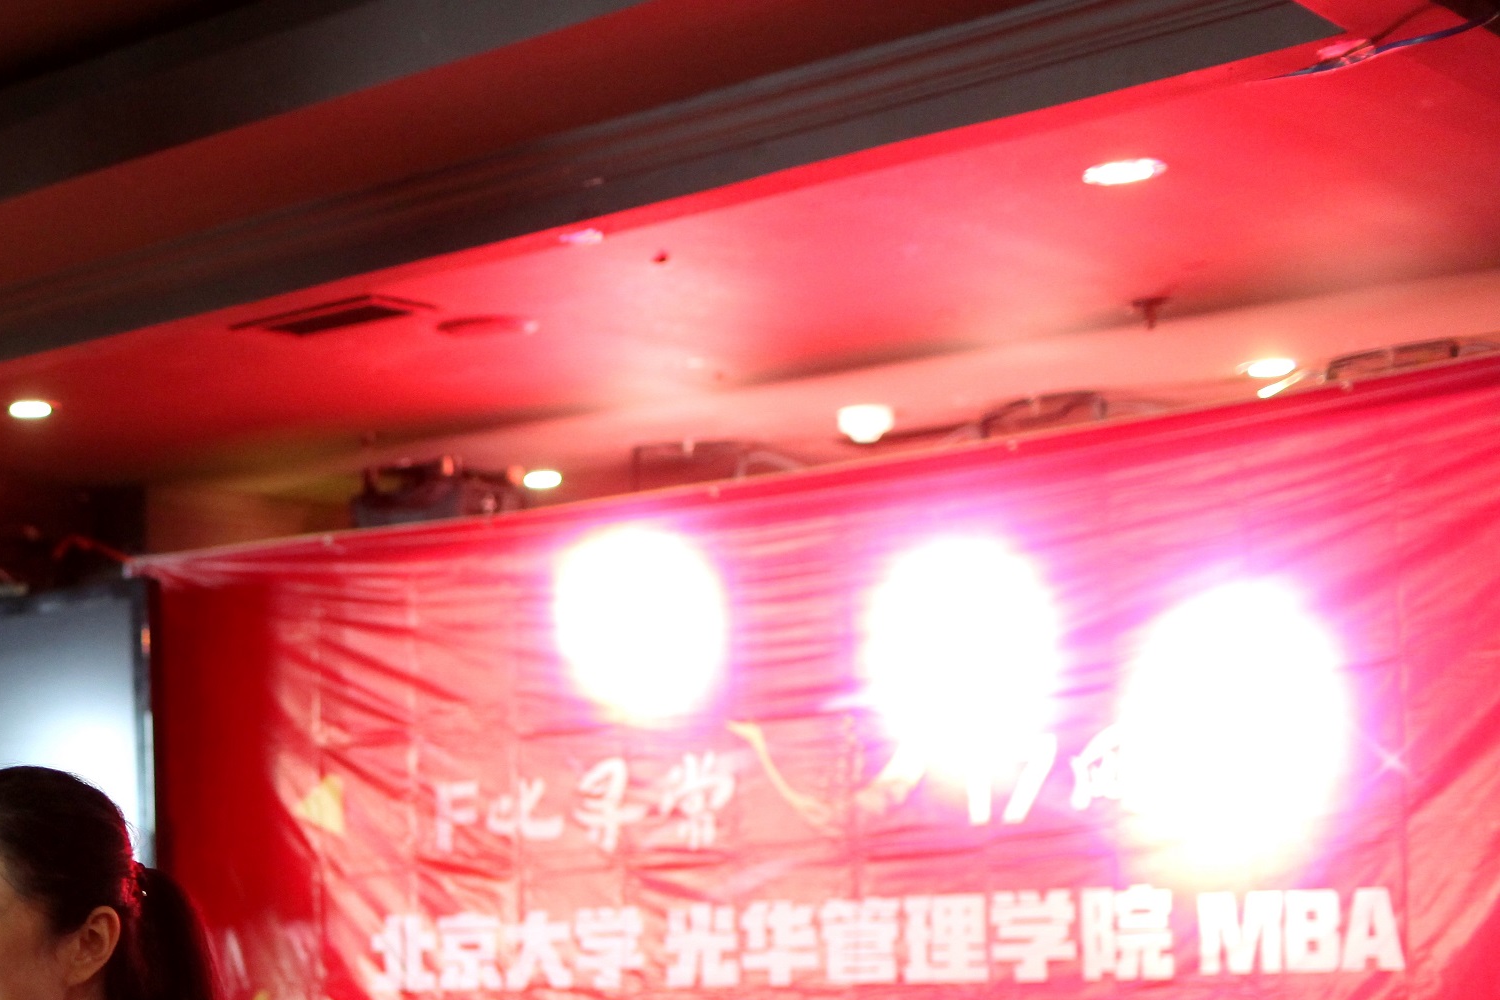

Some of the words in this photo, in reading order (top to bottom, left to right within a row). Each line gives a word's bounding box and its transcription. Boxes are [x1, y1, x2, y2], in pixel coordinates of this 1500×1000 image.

[371, 908, 643, 992] 北京大学
[664, 883, 1175, 985] 光华管理学院
[1197, 886, 1406, 975] MBA
